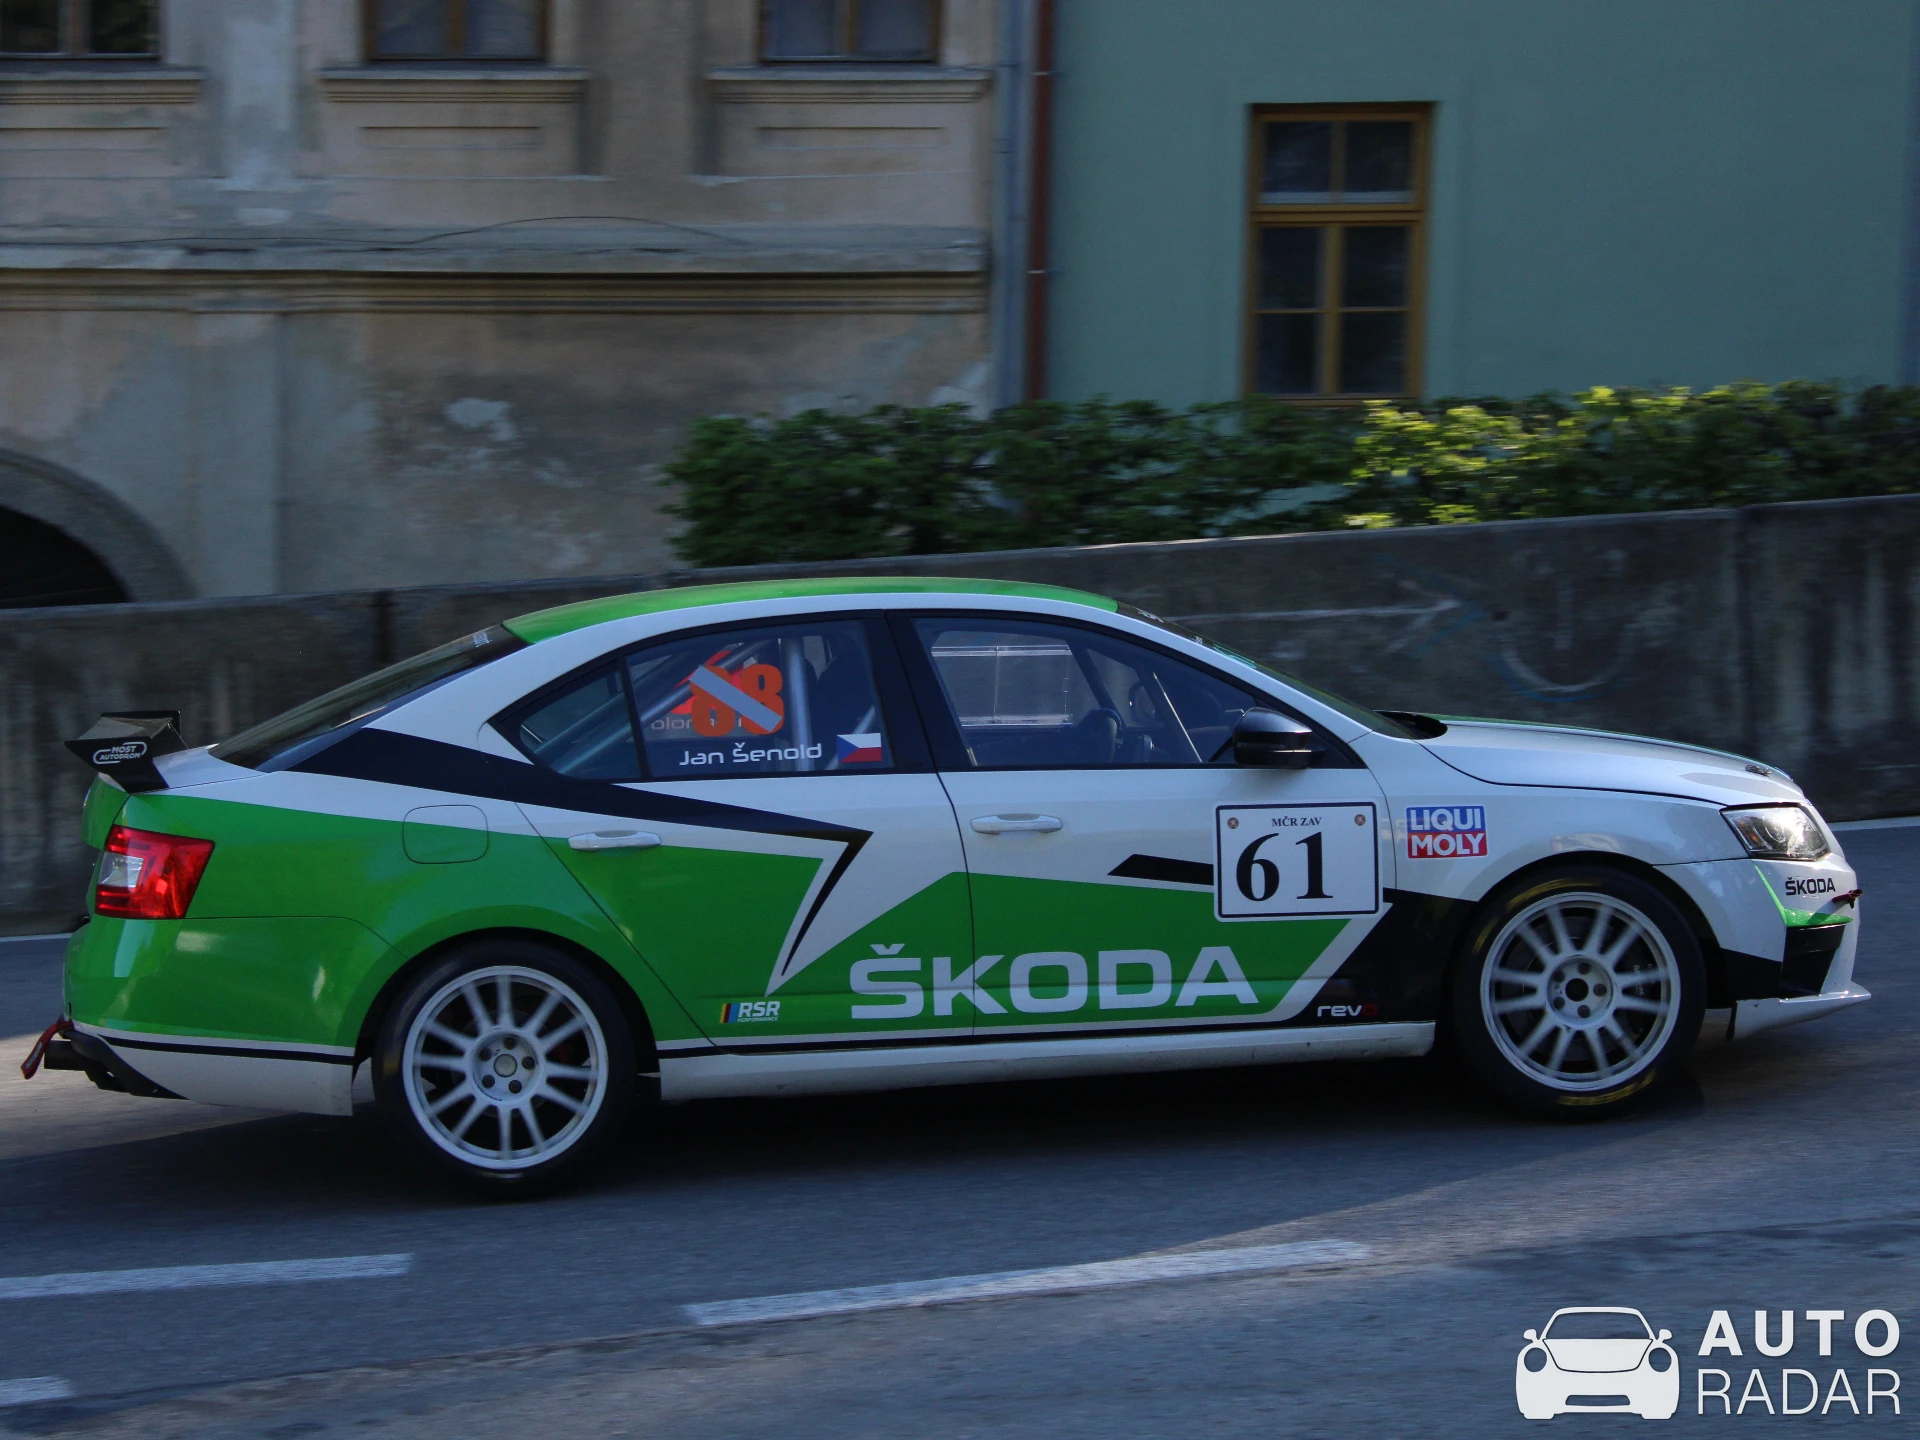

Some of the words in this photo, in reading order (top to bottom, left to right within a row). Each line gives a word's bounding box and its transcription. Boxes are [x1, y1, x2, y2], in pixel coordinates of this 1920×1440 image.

[99, 752, 141, 761] AUTODROM
[111, 745, 137, 754] MOST
[679, 750, 725, 766] Jan
[732, 742, 823, 763] Šenold
[1271, 815, 1299, 827] MČR
[1300, 816, 1323, 827] ZAV
[1408, 807, 1483, 832] LIQUI
[1410, 832, 1486, 857] MOLY
[1235, 831, 1334, 902] 61
[1784, 876, 1837, 896] ŠKODA
[848, 942, 1260, 1020] ŠKODA
[738, 1000, 781, 1018] RSR
